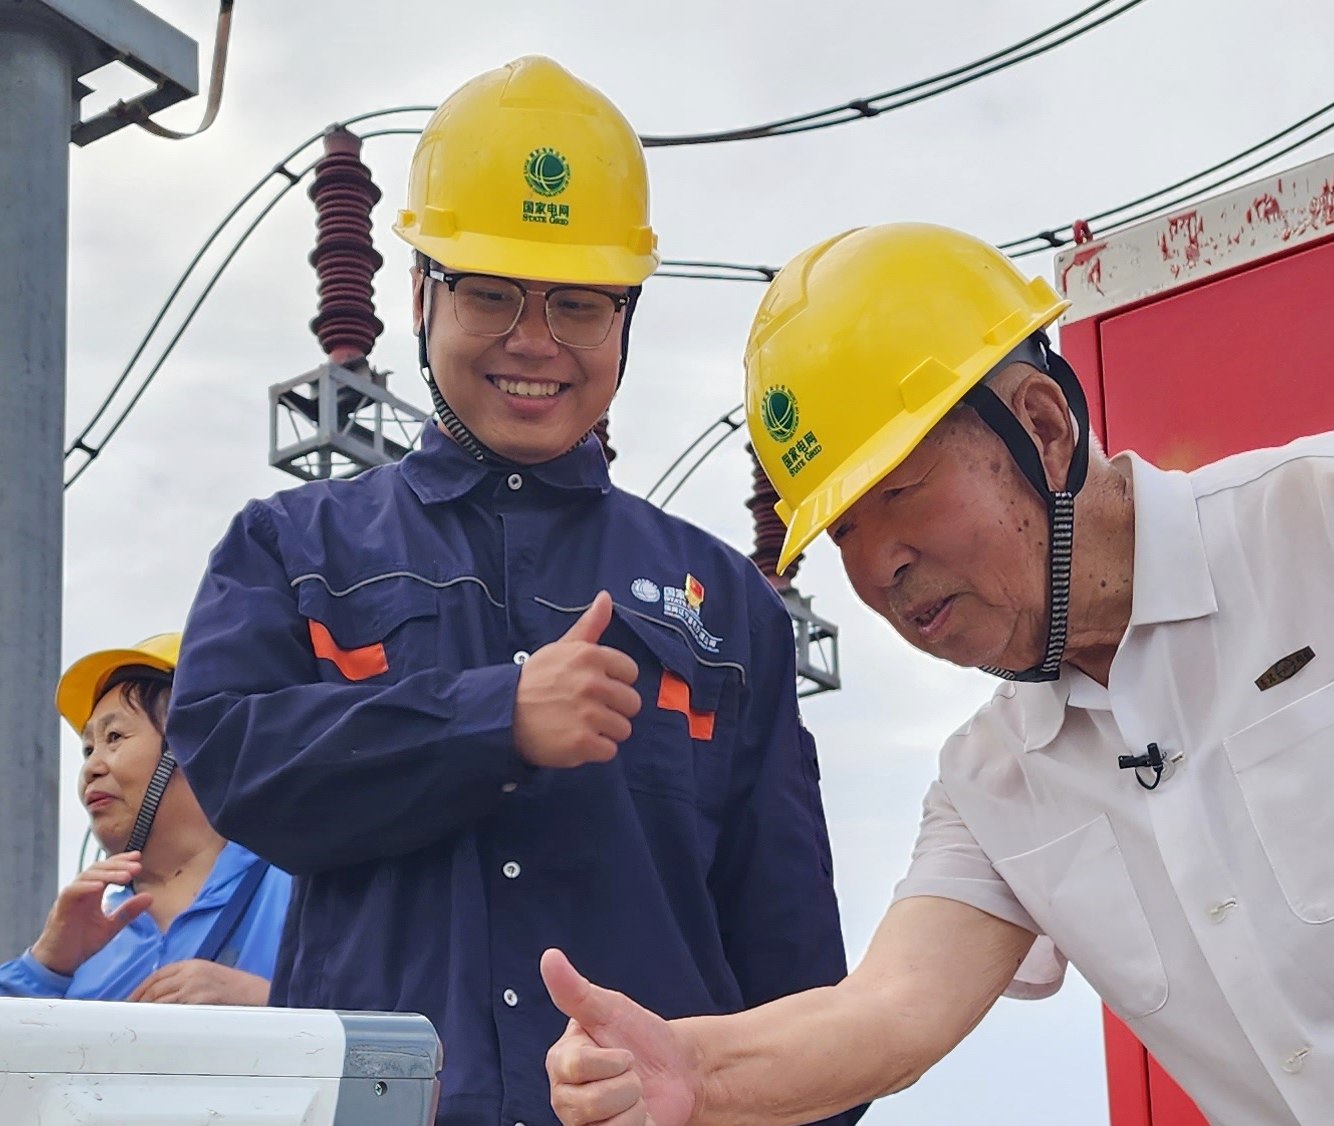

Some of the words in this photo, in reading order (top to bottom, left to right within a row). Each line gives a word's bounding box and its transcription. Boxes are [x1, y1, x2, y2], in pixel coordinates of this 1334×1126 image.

[523, 200, 569, 218] 国家电网
[522, 214, 547, 223] STATE
[549, 216, 569, 225] GRID
[781, 430, 818, 469] 国家电网
